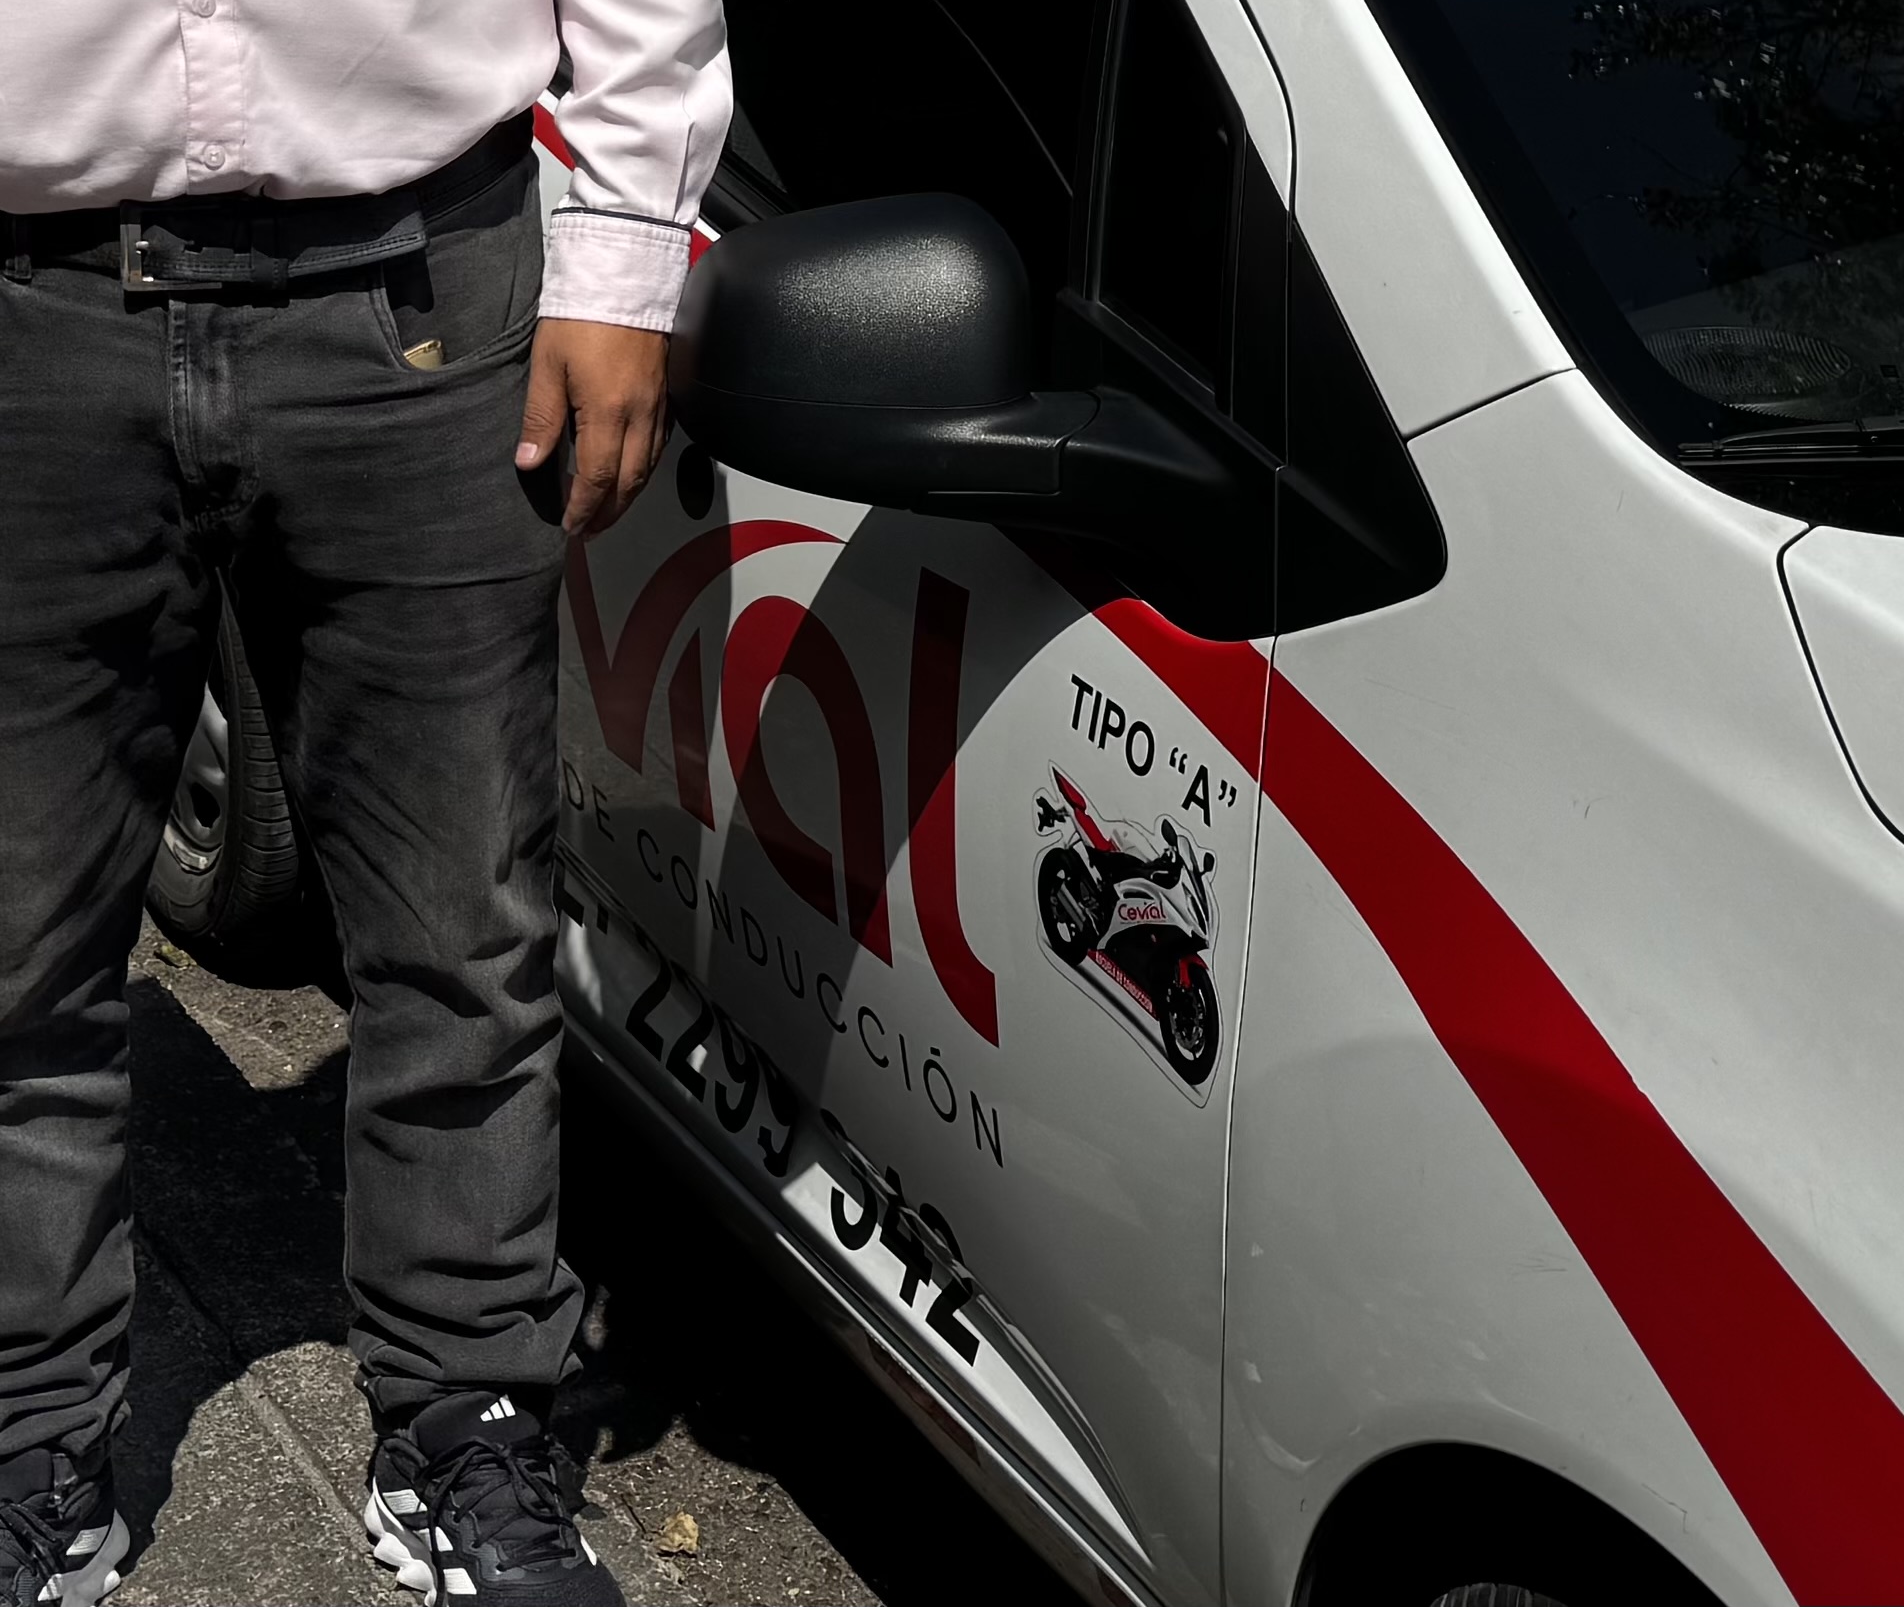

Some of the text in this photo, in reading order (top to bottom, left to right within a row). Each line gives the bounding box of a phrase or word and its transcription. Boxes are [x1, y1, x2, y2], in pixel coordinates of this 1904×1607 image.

[1070, 672, 1156, 777] TIPO
[1117, 900, 1167, 921] Cevial
[635, 827, 1005, 1170] CONDUCCIÓN
